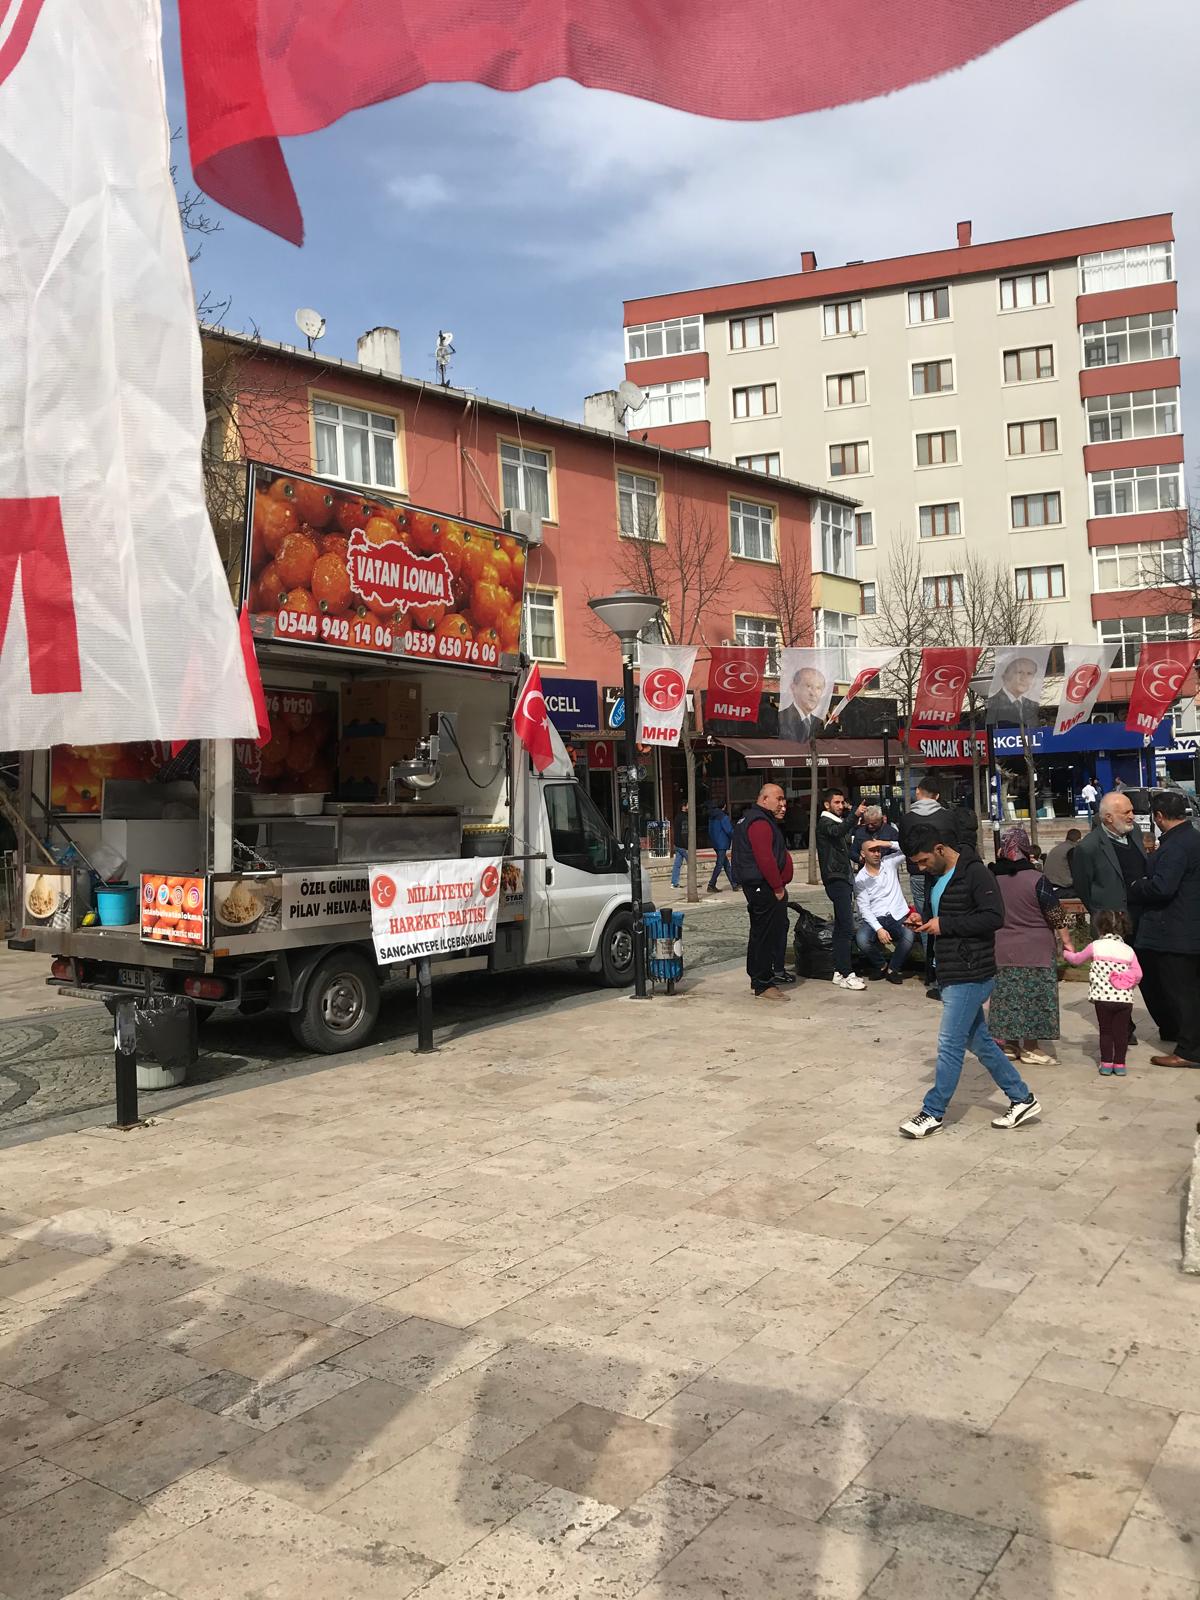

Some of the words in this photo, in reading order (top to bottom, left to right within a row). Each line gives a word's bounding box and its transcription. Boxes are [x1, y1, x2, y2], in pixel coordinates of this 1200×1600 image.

[357, 555, 400, 588] VATAN
[402, 567, 445, 597] LOKMA
[278, 610, 317, 635] 0544
[322, 617, 349, 641] 942
[354, 622, 371, 644] 14
[375, 626, 392, 647] 06
[405, 630, 436, 653] 0539
[439, 636, 462, 657] 650
[464, 641, 479, 660] 76
[481, 645, 496, 662] 06
[713, 703, 752, 717] MHP
[919, 710, 956, 722] MHP
[642, 726, 679, 741] MHP
[920, 739, 960, 758] SANCAK
[301, 878, 326, 896] ÖZEL
[407, 877, 474, 904] MİLLİYETÇİ
[505, 894, 523, 902] STAR
[290, 901, 320, 918] PİLAV
[389, 912, 447, 935] HAREKET
[449, 906, 487, 926] PARTİSİ
[380, 939, 439, 960] SANCAKTEPE
